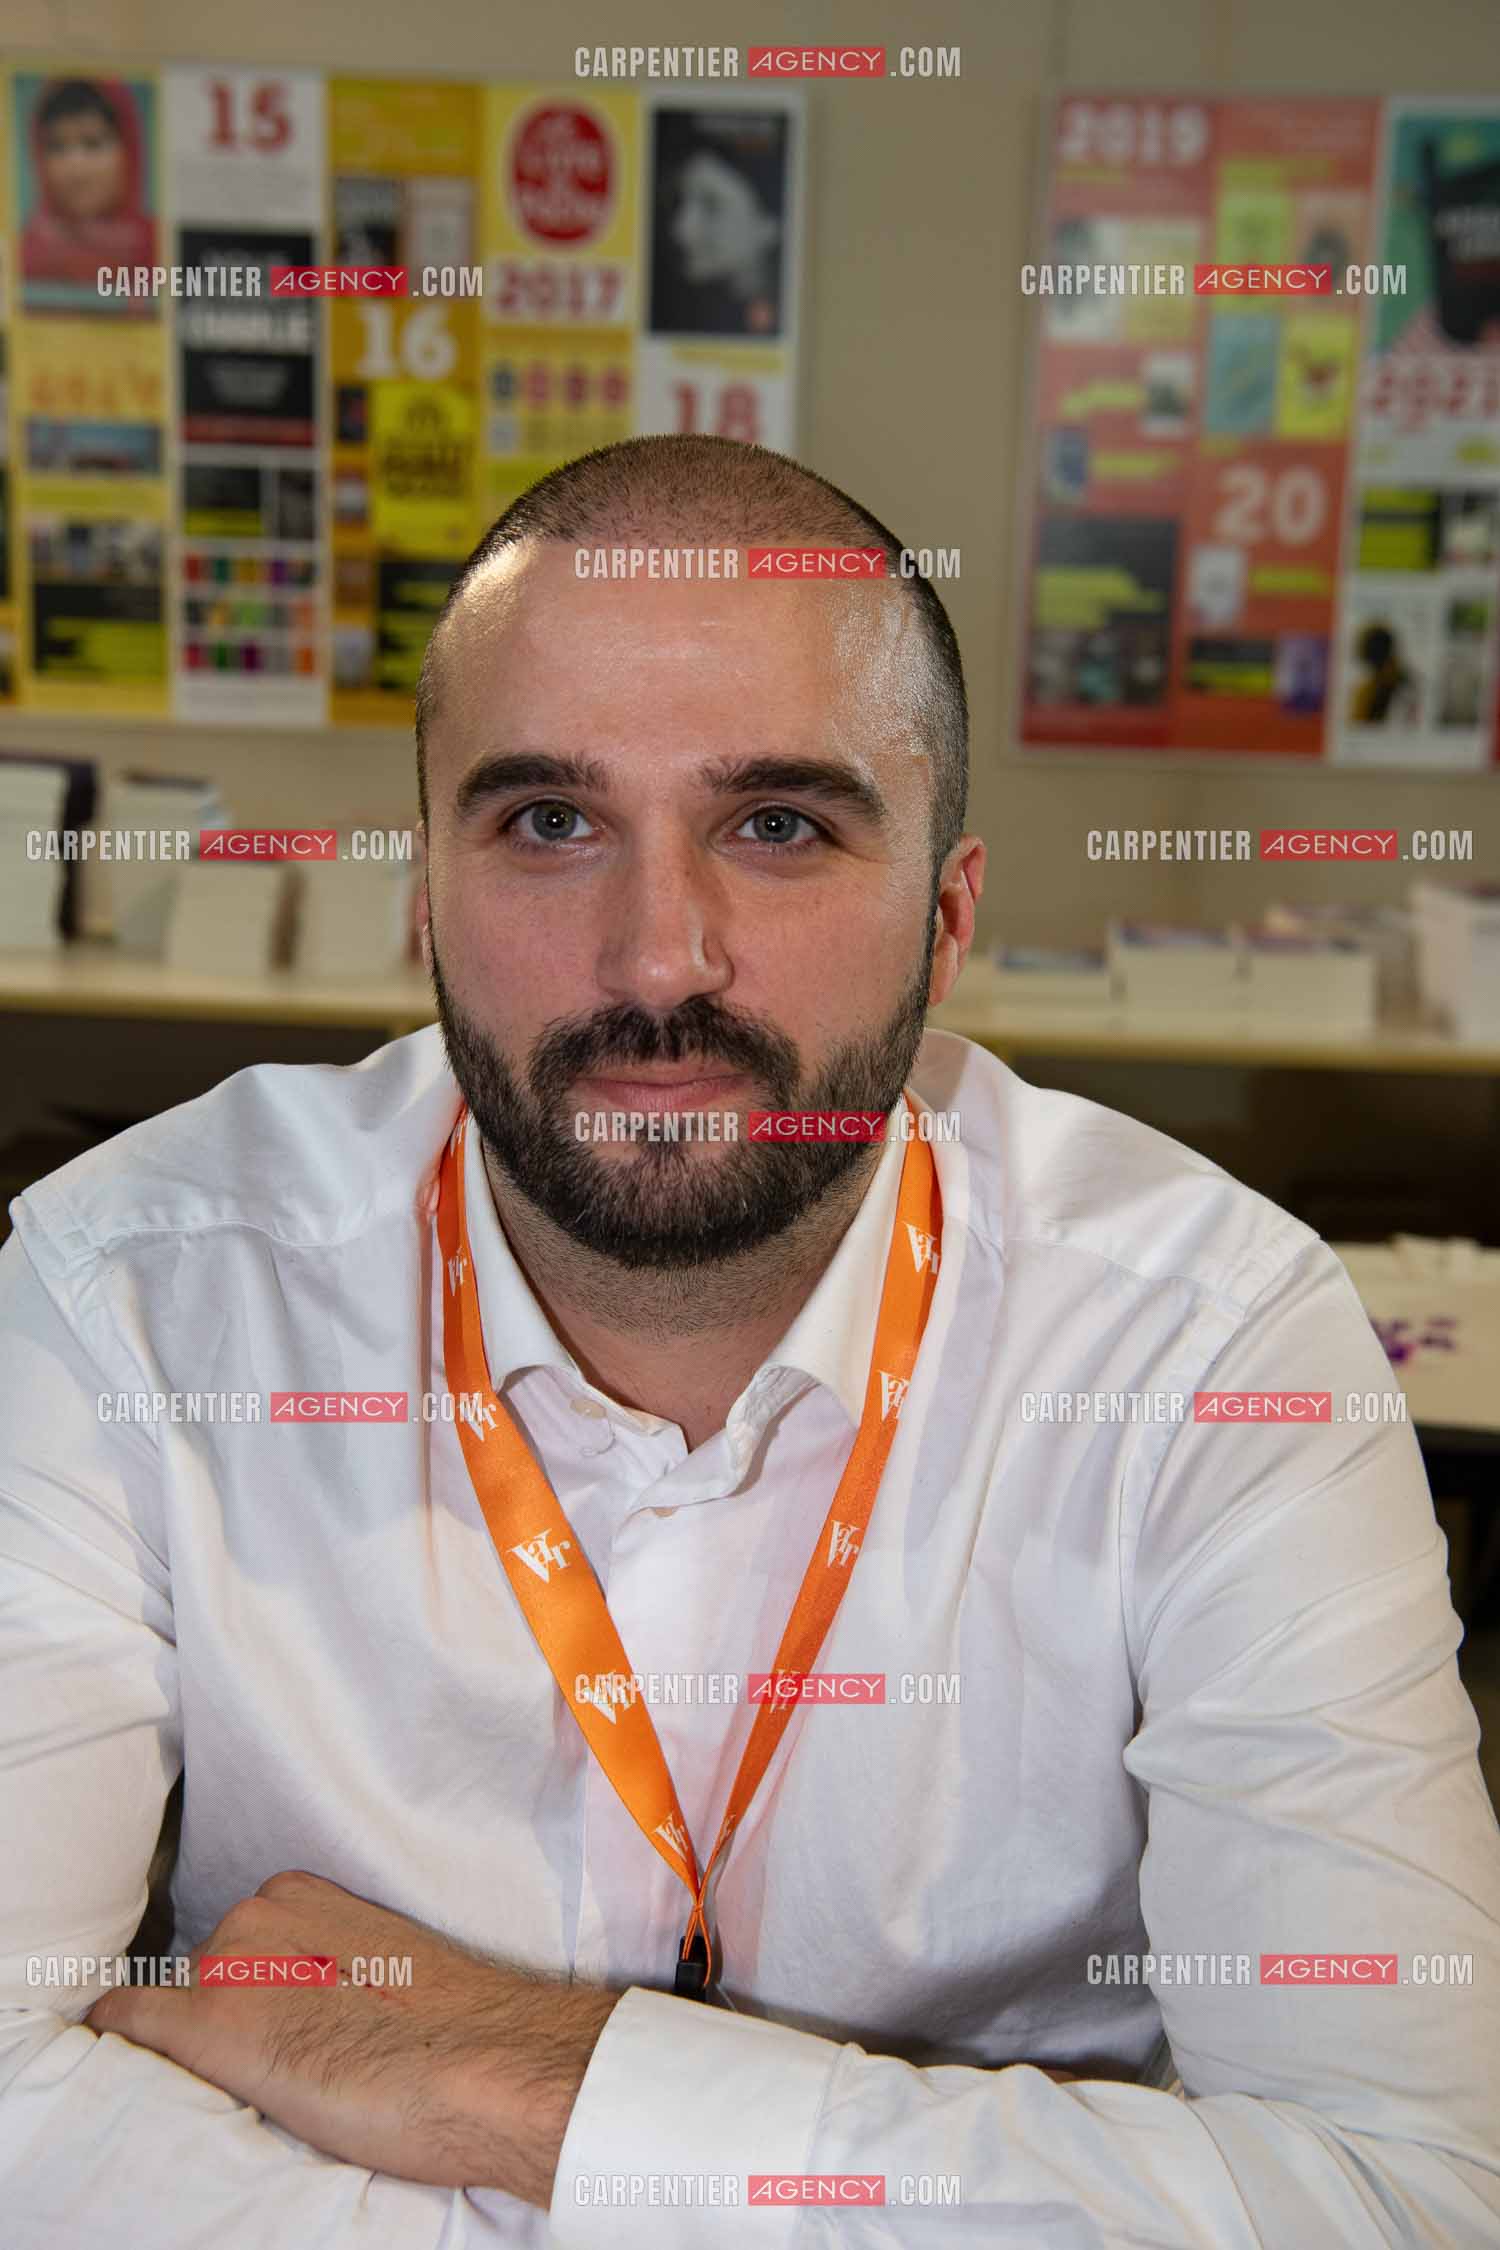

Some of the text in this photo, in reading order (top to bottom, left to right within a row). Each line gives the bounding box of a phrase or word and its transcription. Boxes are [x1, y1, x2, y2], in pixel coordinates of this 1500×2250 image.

[207, 78, 294, 152] 15
[496, 262, 622, 317] 2017
[355, 302, 457, 381] 16
[1213, 463, 1327, 546] 20
[509, 1528, 571, 1583] Var
